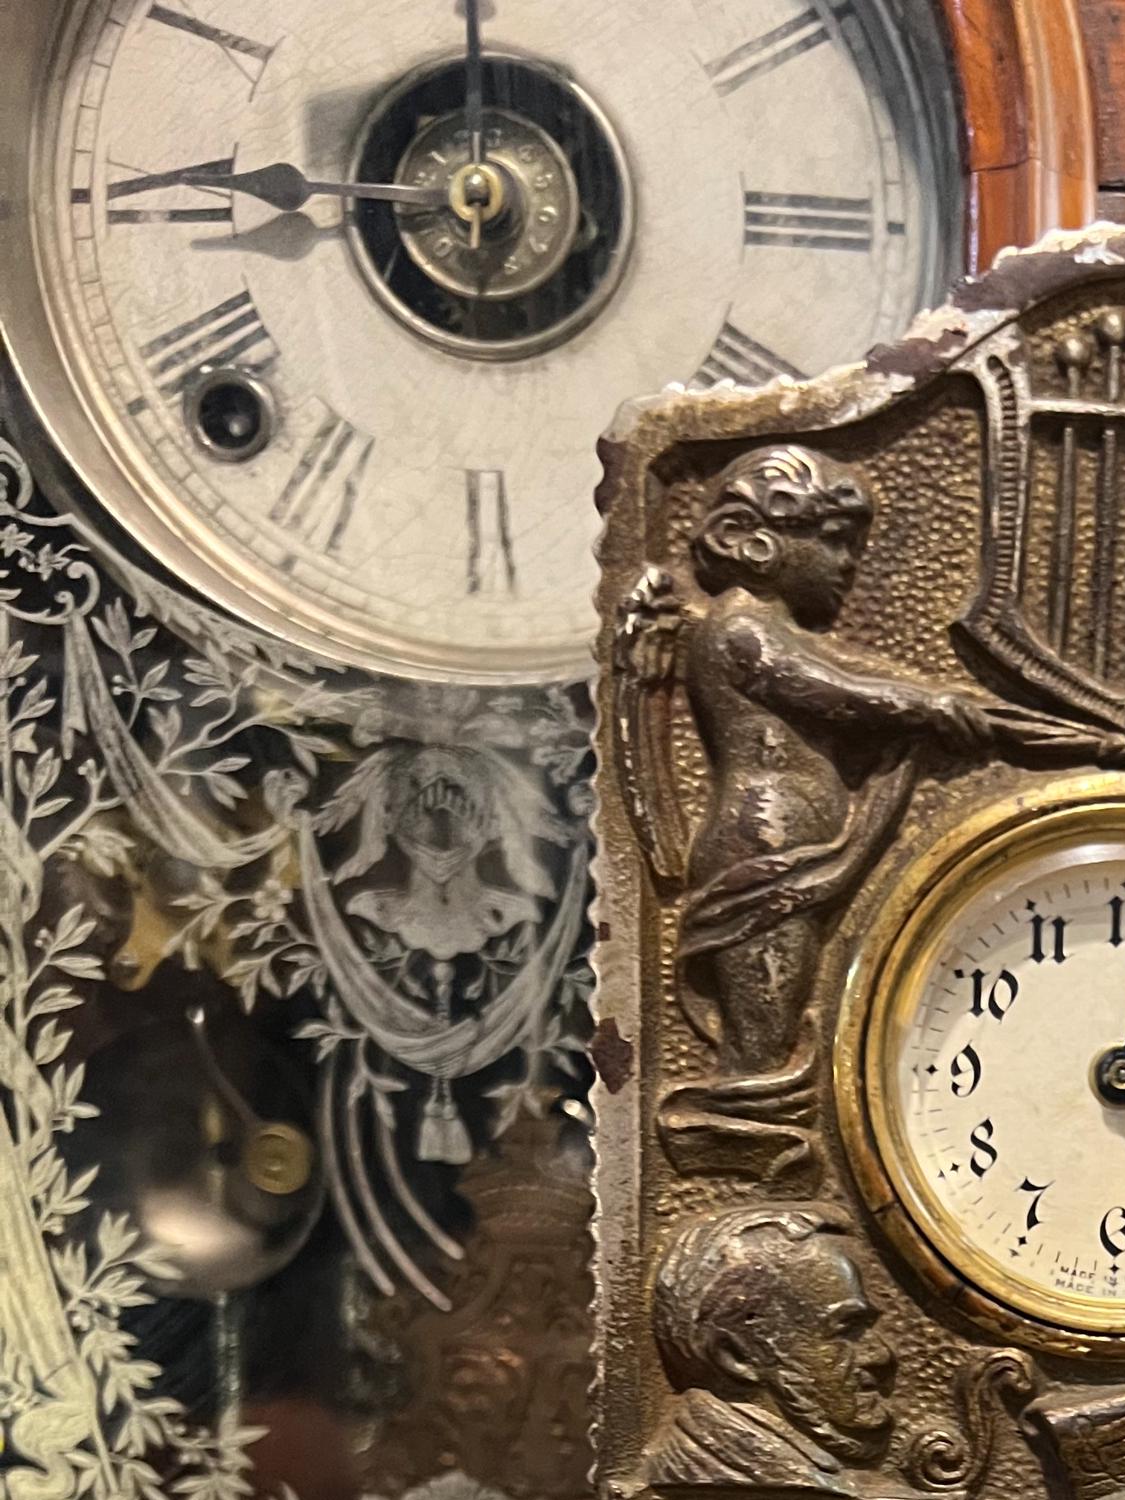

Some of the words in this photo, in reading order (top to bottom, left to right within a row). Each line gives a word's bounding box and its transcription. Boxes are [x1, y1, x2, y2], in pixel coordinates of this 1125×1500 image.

[740, 178, 873, 262] III
[1029, 912, 1073, 964] 11
[968, 966, 1019, 1021] 10
[950, 1043, 983, 1098] 9
[969, 1117, 998, 1178] 8
[1018, 1176, 1053, 1231] 7
